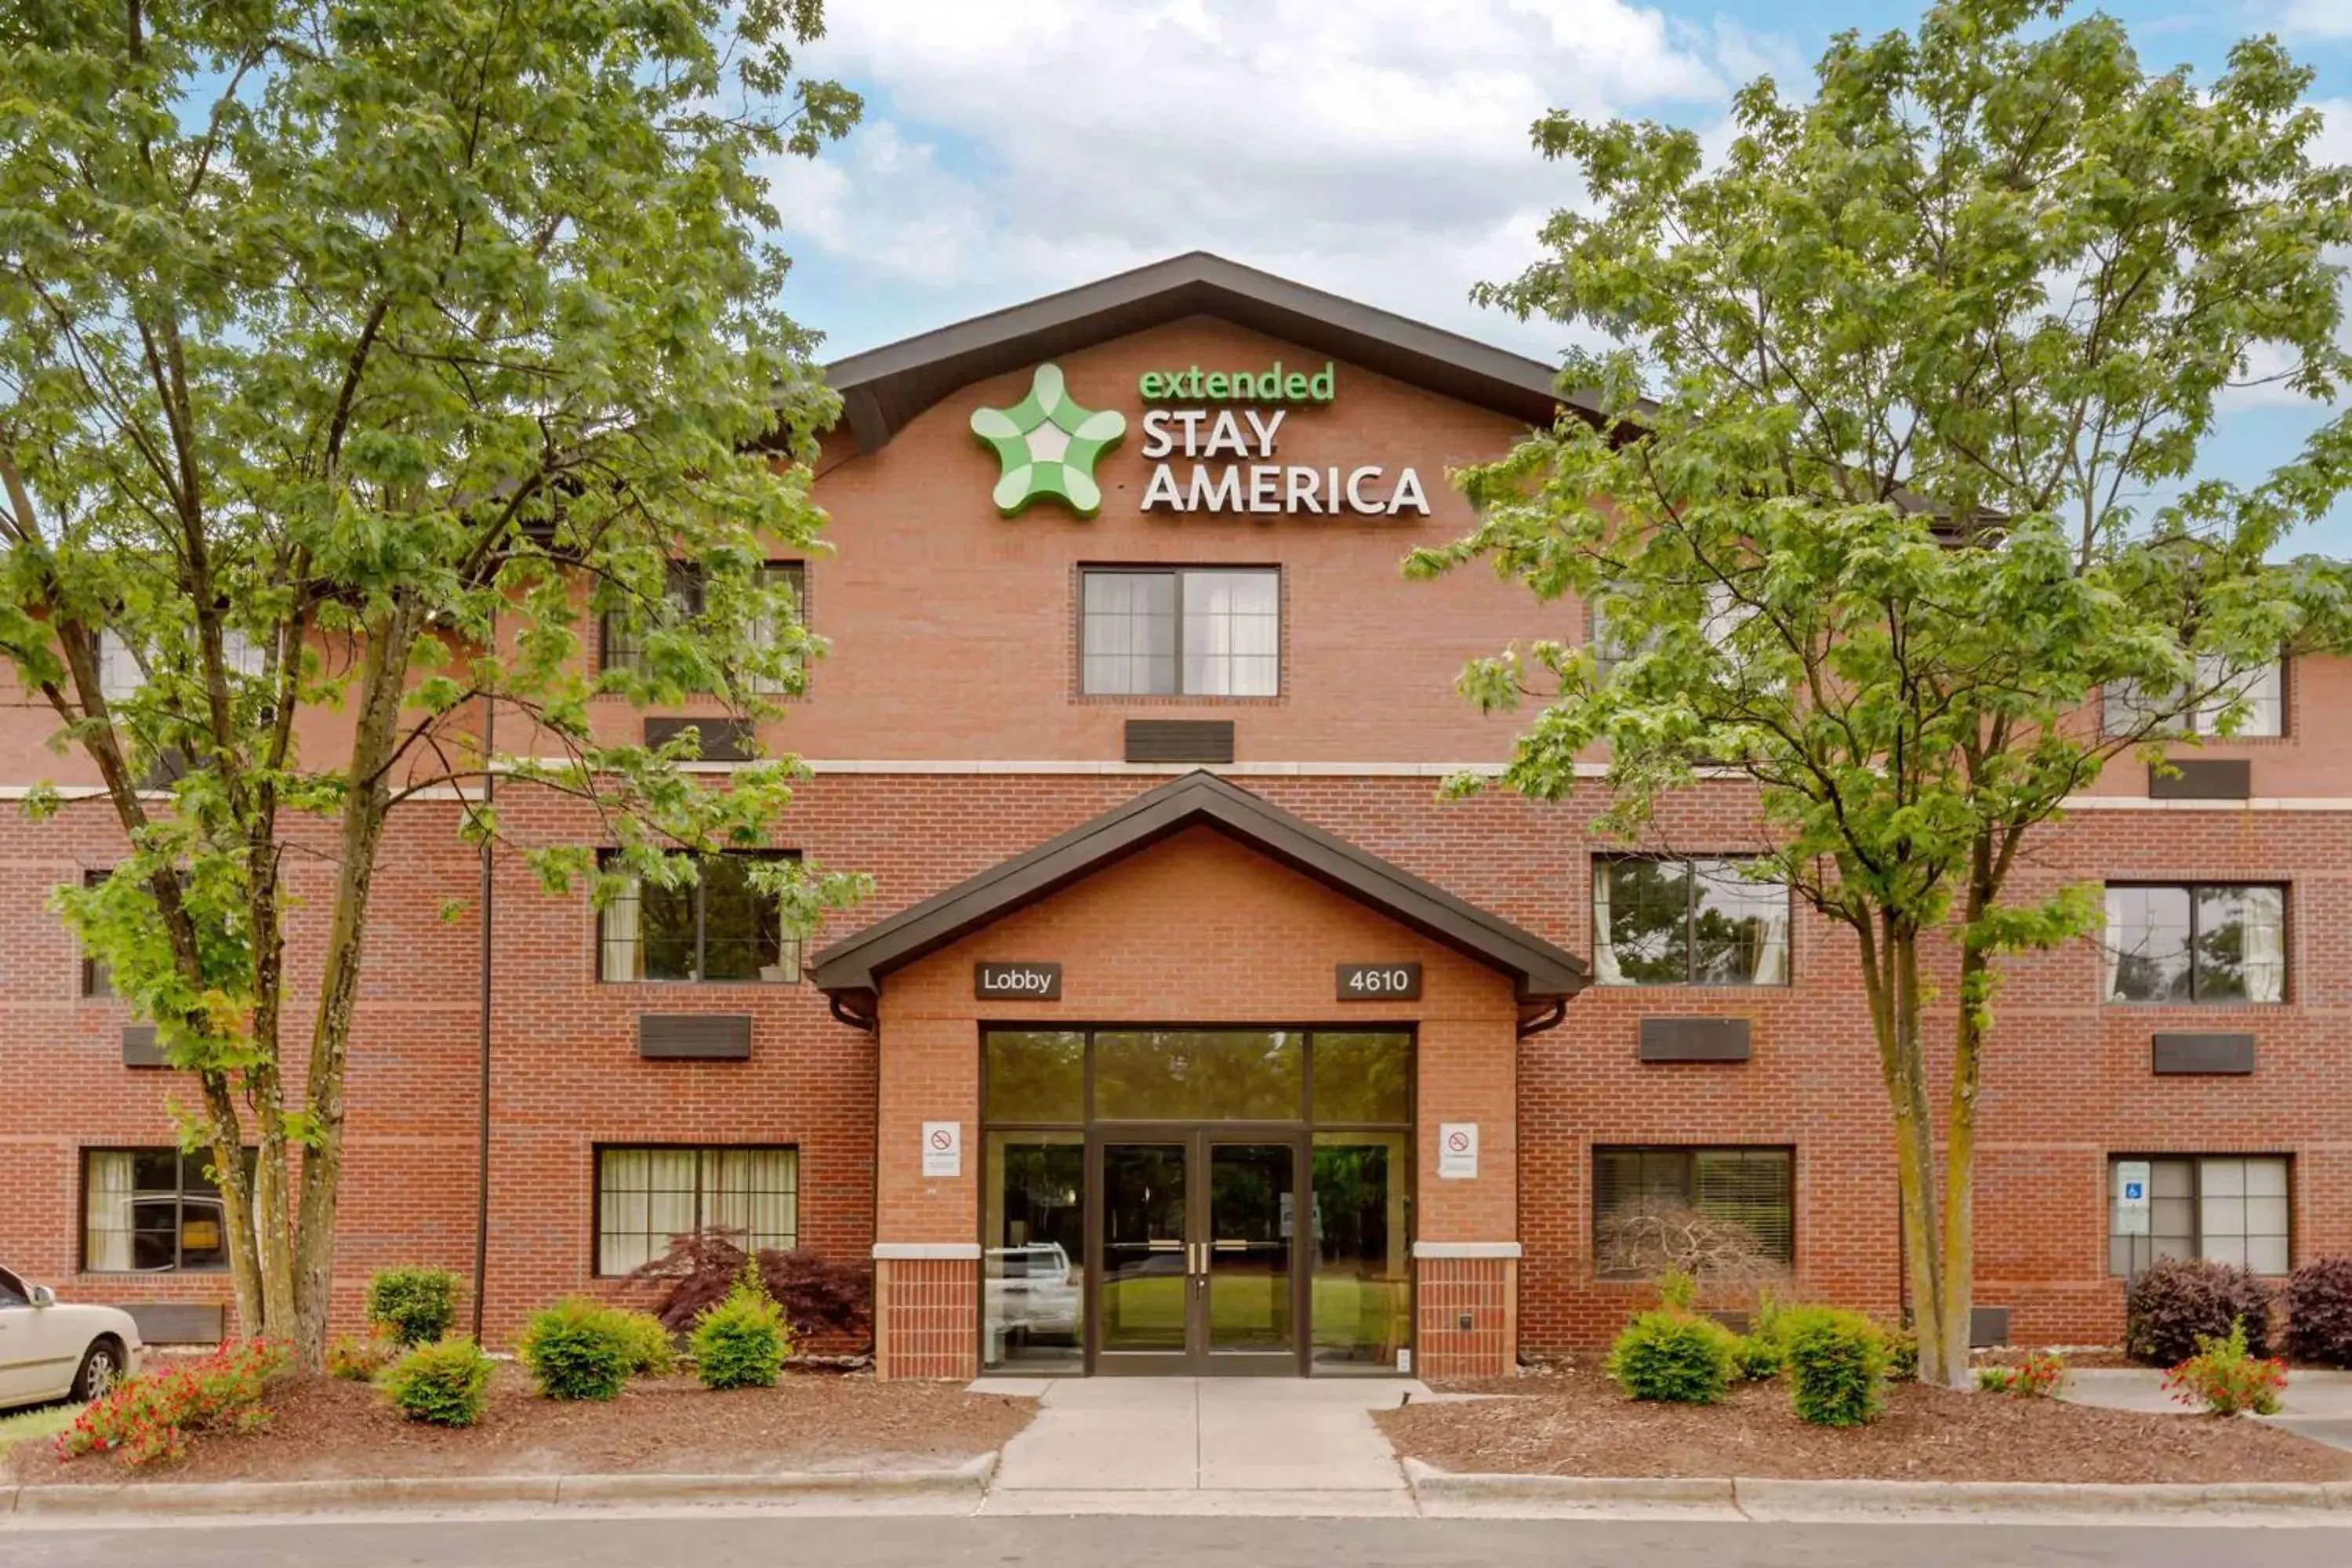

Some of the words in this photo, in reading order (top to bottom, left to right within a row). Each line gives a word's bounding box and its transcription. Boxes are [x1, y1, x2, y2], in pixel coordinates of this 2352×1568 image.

[1139, 361, 1334, 401] extended
[1142, 409, 1286, 458] STAY
[1141, 464, 1431, 515] AMERICA
[985, 969, 1052, 993] Lobby
[1349, 970, 1408, 991] 4610
